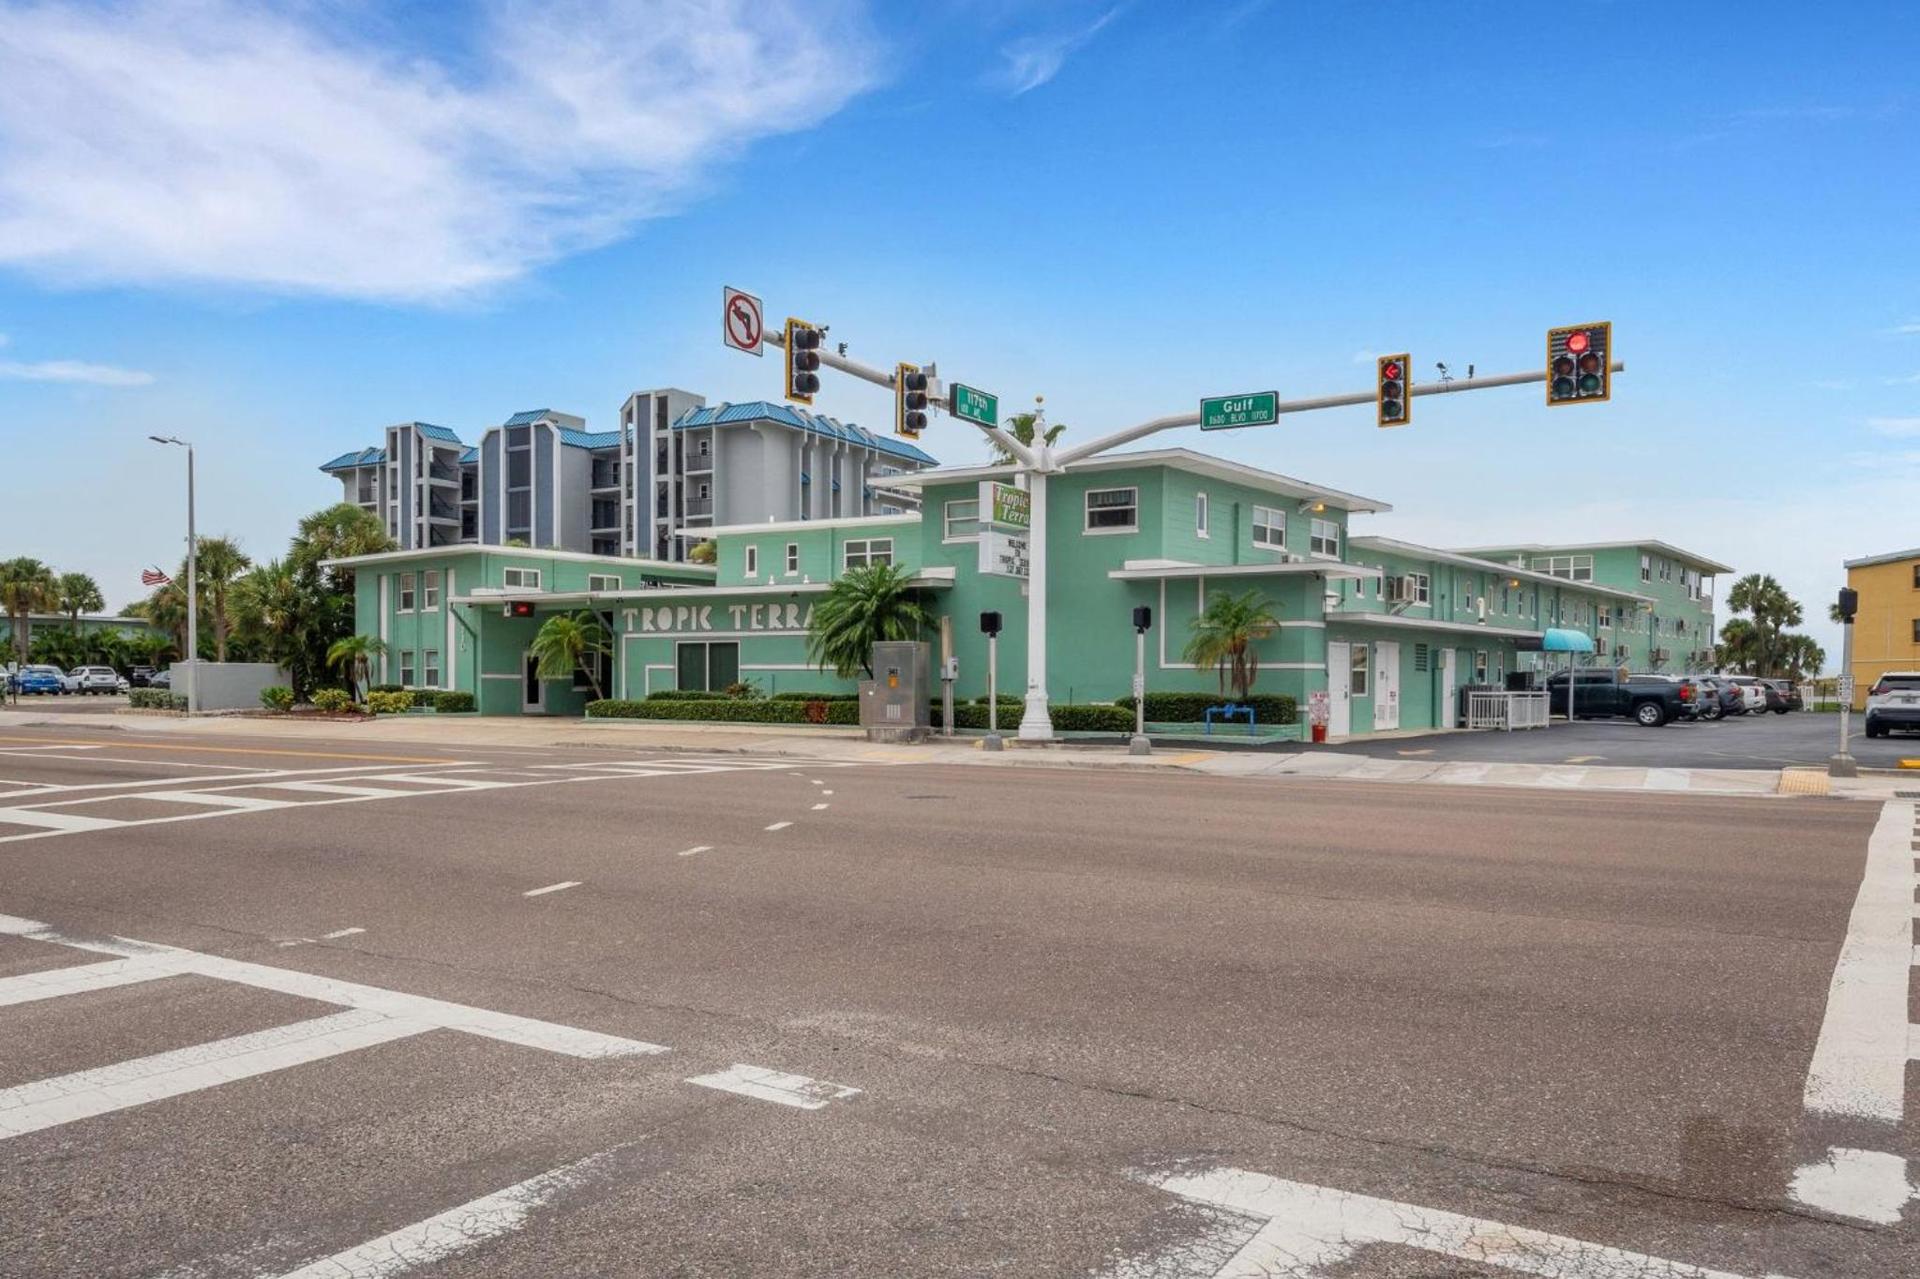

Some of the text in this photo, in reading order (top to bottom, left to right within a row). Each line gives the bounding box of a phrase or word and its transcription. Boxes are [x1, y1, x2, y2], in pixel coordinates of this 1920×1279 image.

[967, 391, 987, 411] 117th
[1223, 398, 1253, 412] Gulf
[1230, 412, 1246, 423] BLVD
[995, 486, 1029, 510] Tropic
[1002, 505, 1029, 524] Terra
[1008, 538, 1026, 550] WELCOME
[622, 602, 816, 631] TROPIC TERRA
